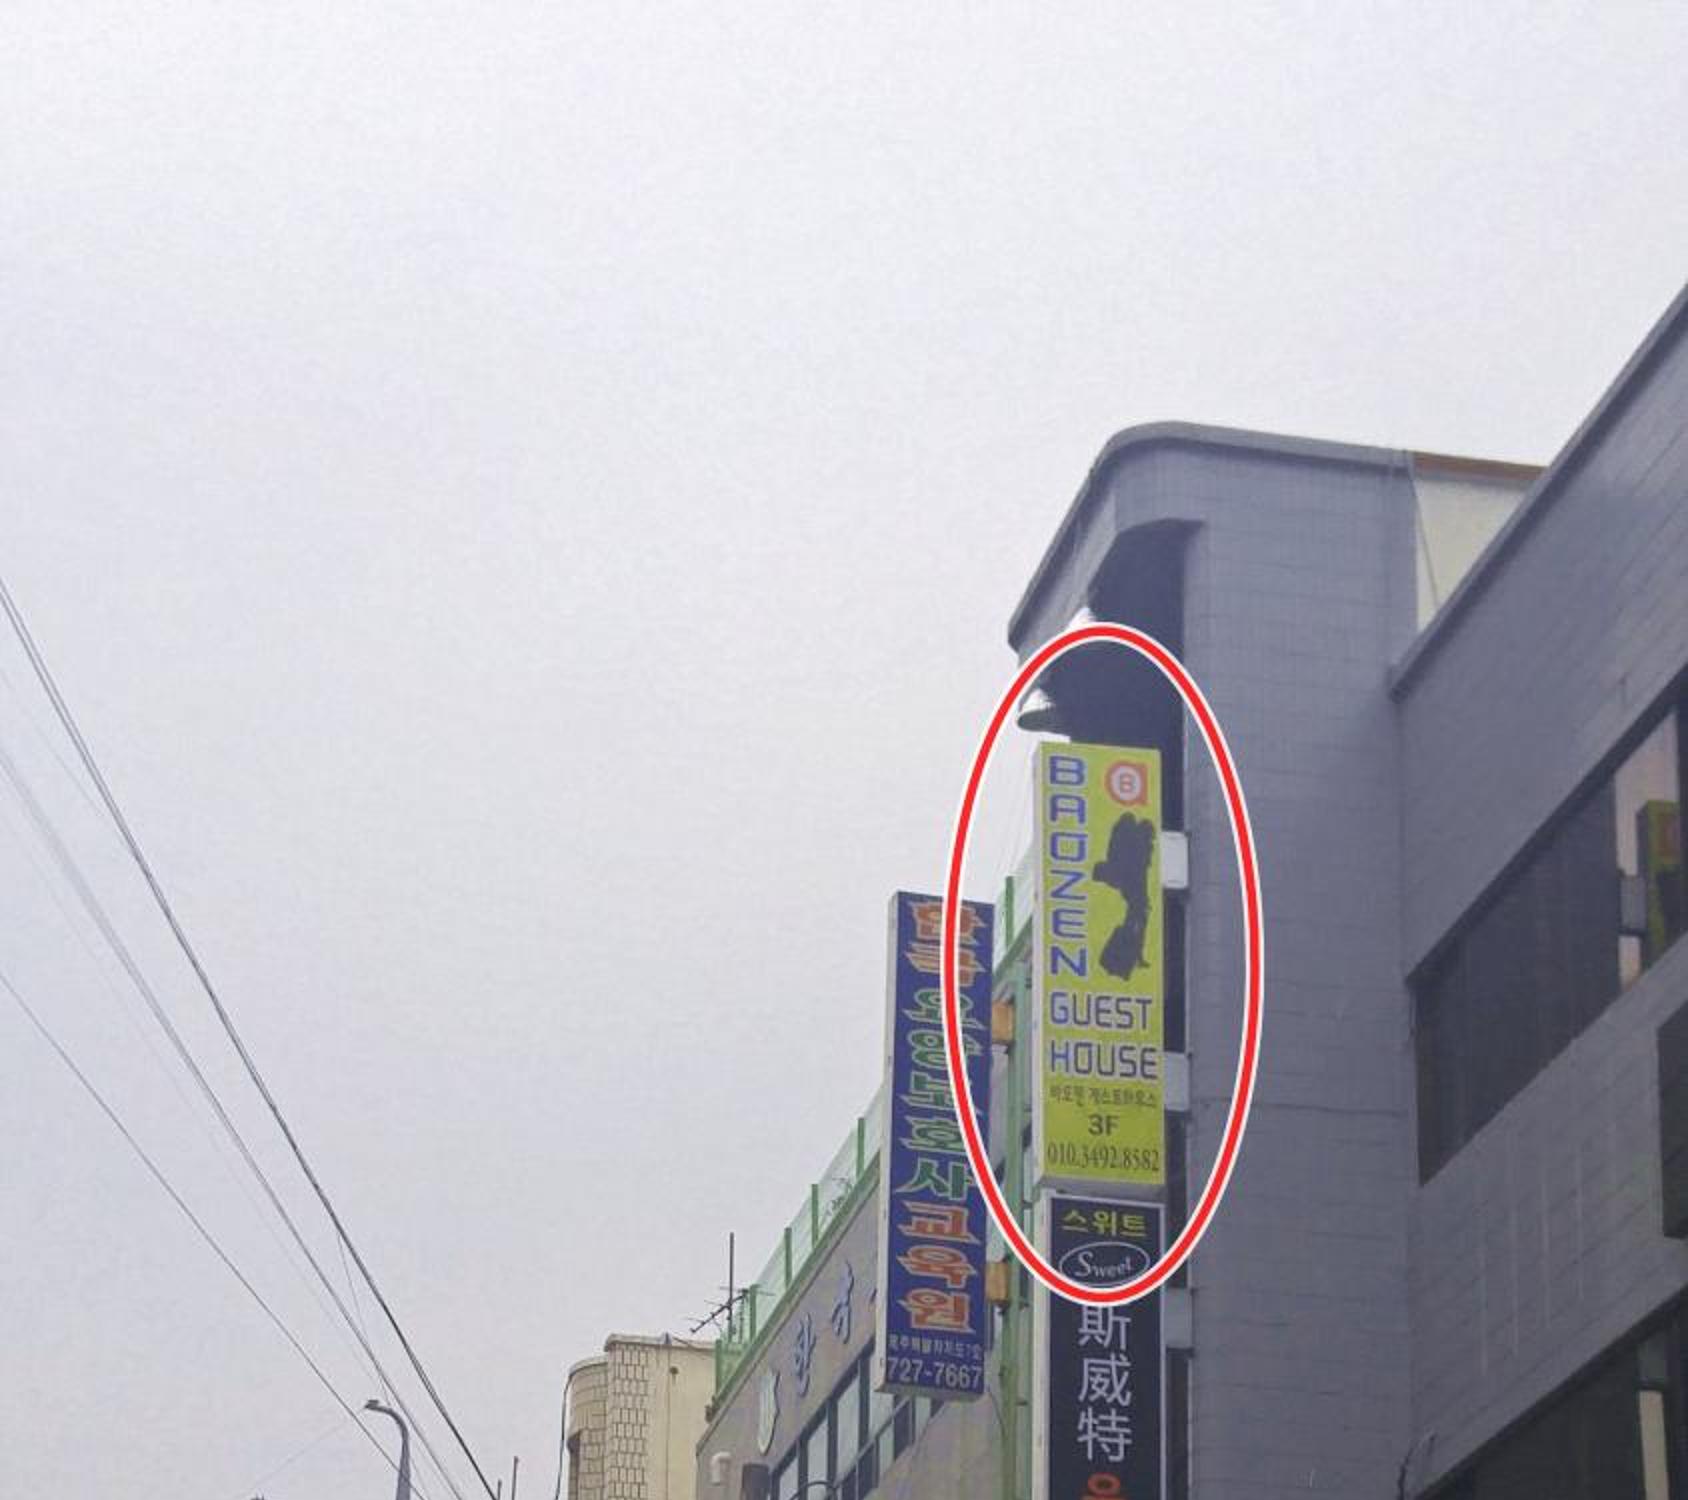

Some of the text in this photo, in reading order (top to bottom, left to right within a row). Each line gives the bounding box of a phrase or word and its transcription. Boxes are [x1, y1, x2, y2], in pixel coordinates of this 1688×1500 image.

[1050, 991, 1153, 1030] GUEST
[1050, 1039, 1158, 1080] HOUSE
[1087, 1114, 1120, 1137] 3F
[1062, 1209, 1146, 1237] 스위트
[887, 1355, 982, 1390] 727-7667
